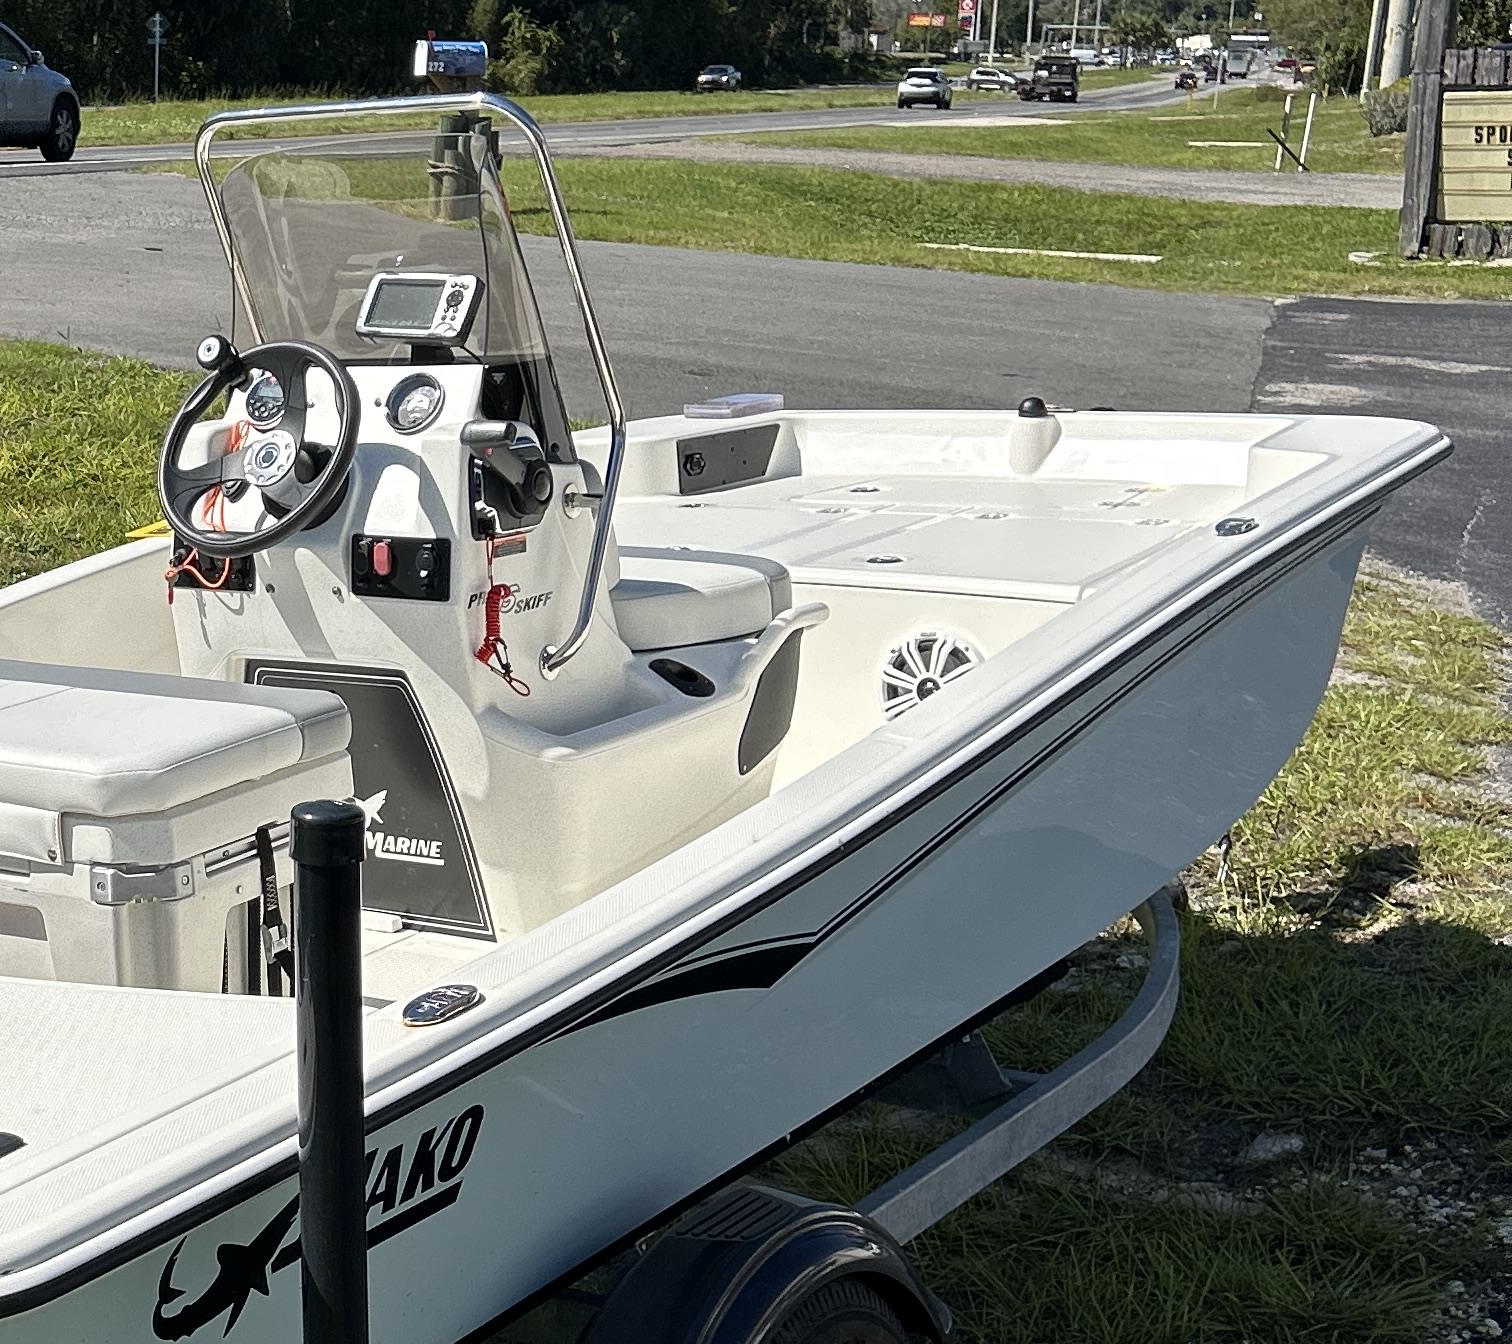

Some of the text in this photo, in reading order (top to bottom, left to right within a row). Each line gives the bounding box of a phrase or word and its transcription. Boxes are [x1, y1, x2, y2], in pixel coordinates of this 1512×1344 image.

[1474, 125, 1512, 145] SPO
[513, 591, 553, 614] SKIFF
[366, 831, 443, 857] MARINE
